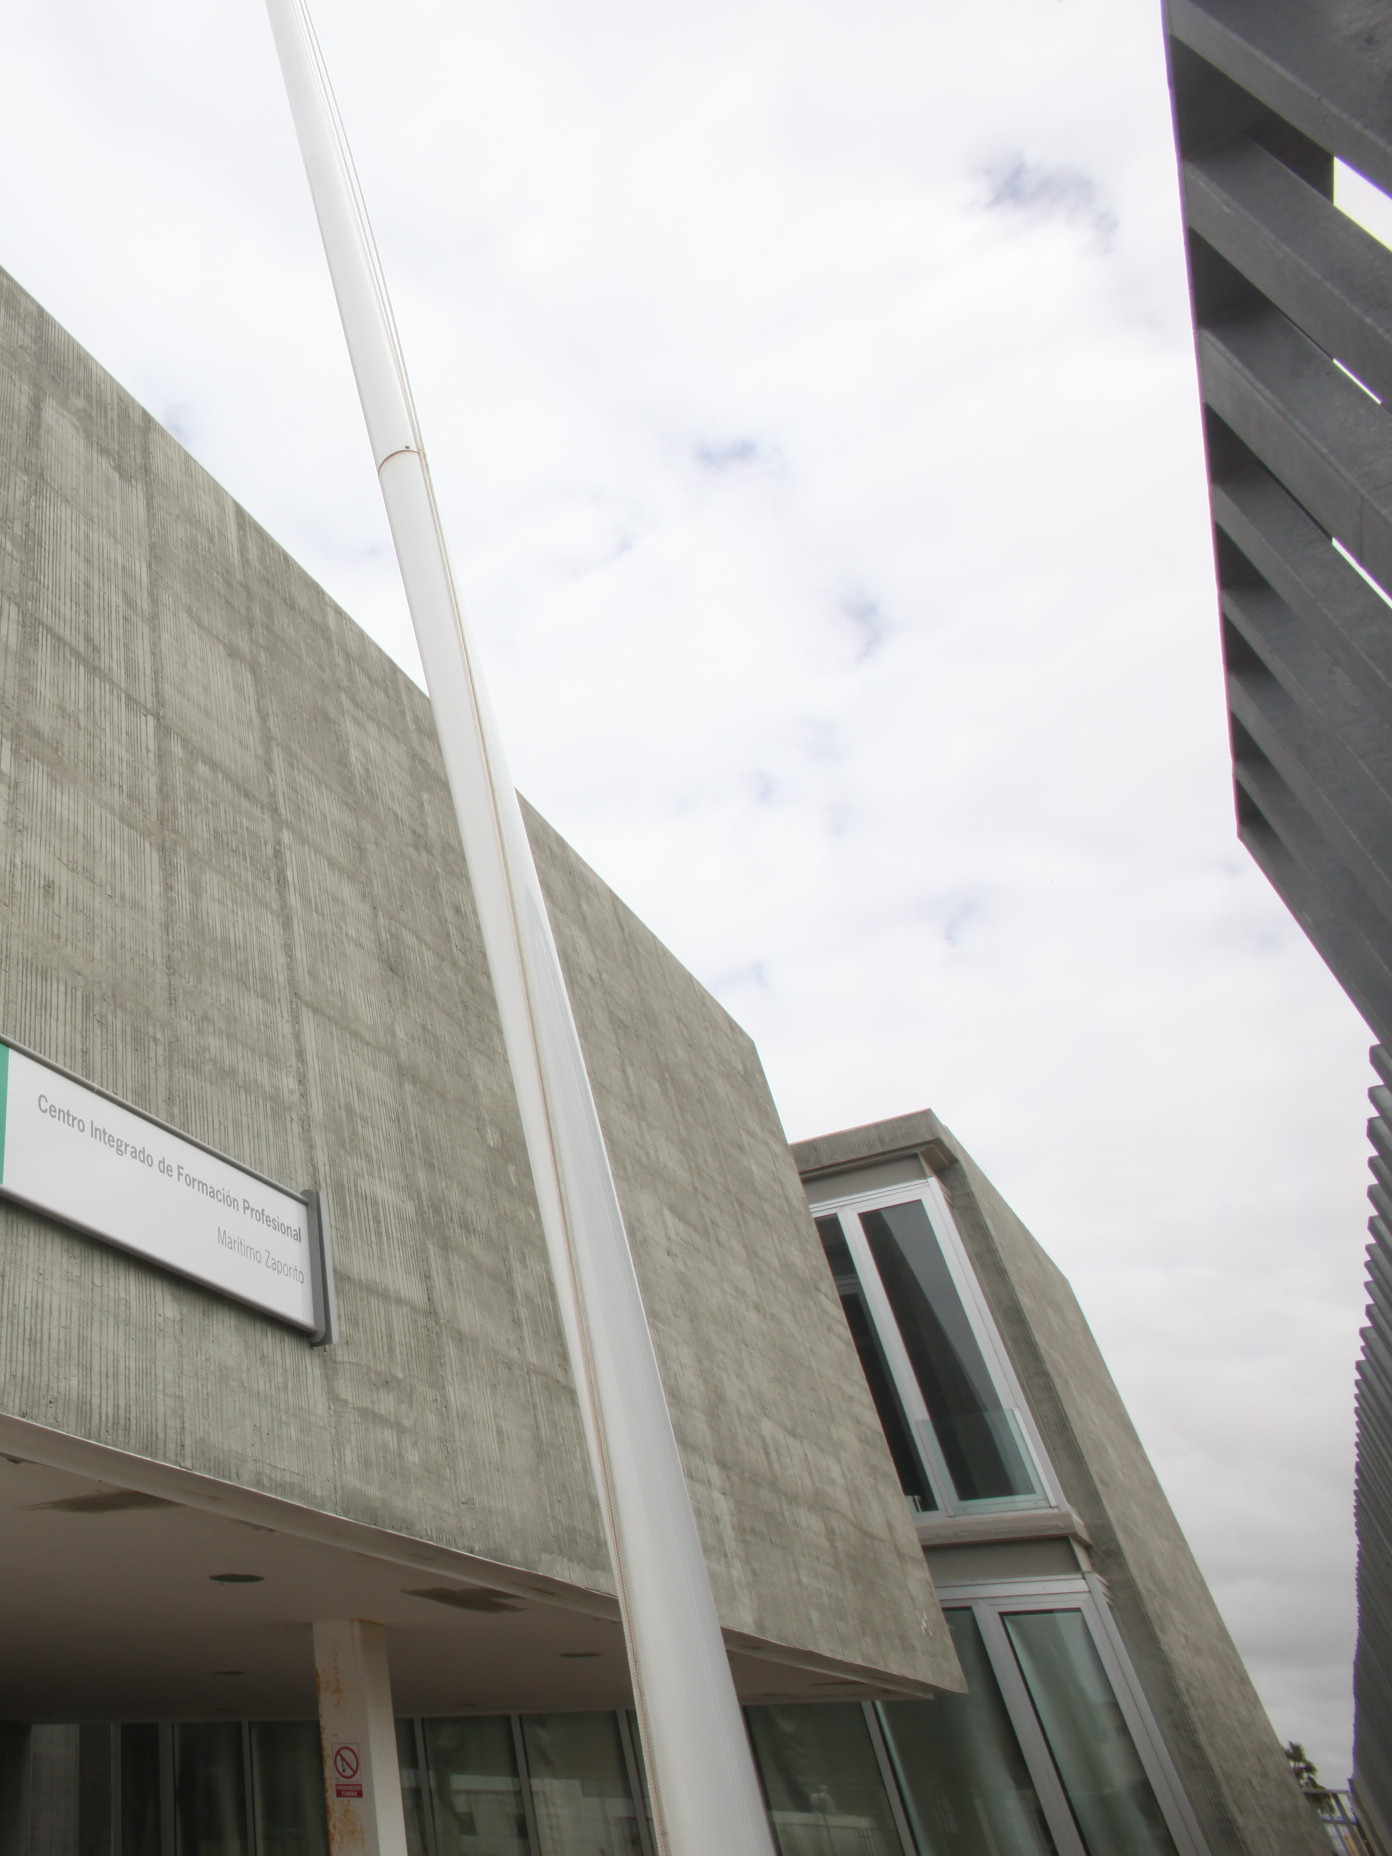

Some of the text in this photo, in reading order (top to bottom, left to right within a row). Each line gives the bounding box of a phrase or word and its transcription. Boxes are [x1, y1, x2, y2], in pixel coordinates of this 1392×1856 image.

[37, 1094, 302, 1244] Centro Integrado de Formación Profesional
[264, 1249, 305, 1284] Zaporito
